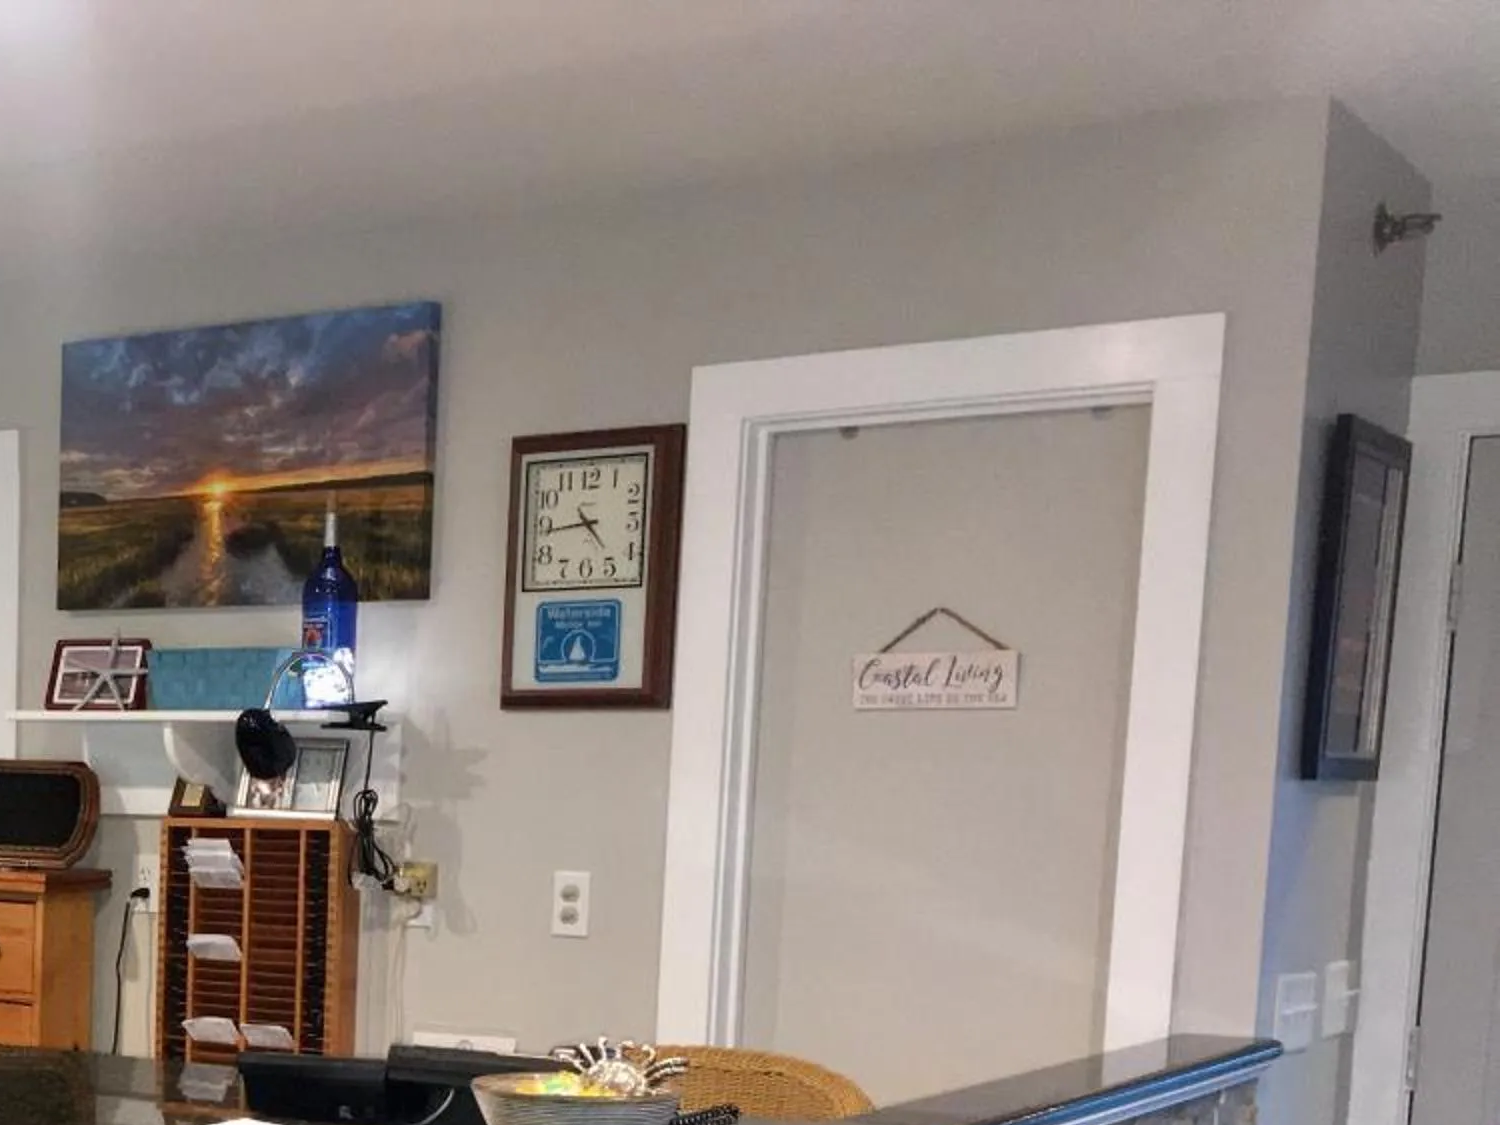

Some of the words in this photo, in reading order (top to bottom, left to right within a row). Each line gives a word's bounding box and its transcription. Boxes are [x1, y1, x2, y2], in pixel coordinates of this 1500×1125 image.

[559, 471, 573, 492] 11
[582, 467, 601, 490] 12
[541, 490, 559, 509] 10
[627, 483, 640, 504] 2
[539, 515, 553, 536] 9
[627, 511, 639, 532] 3
[538, 544, 552, 565] 8
[558, 558, 569, 579] 7
[580, 557, 593, 578] 6
[604, 556, 617, 577] 5
[858, 657, 941, 690] Coastal
[944, 655, 1003, 694] Living
